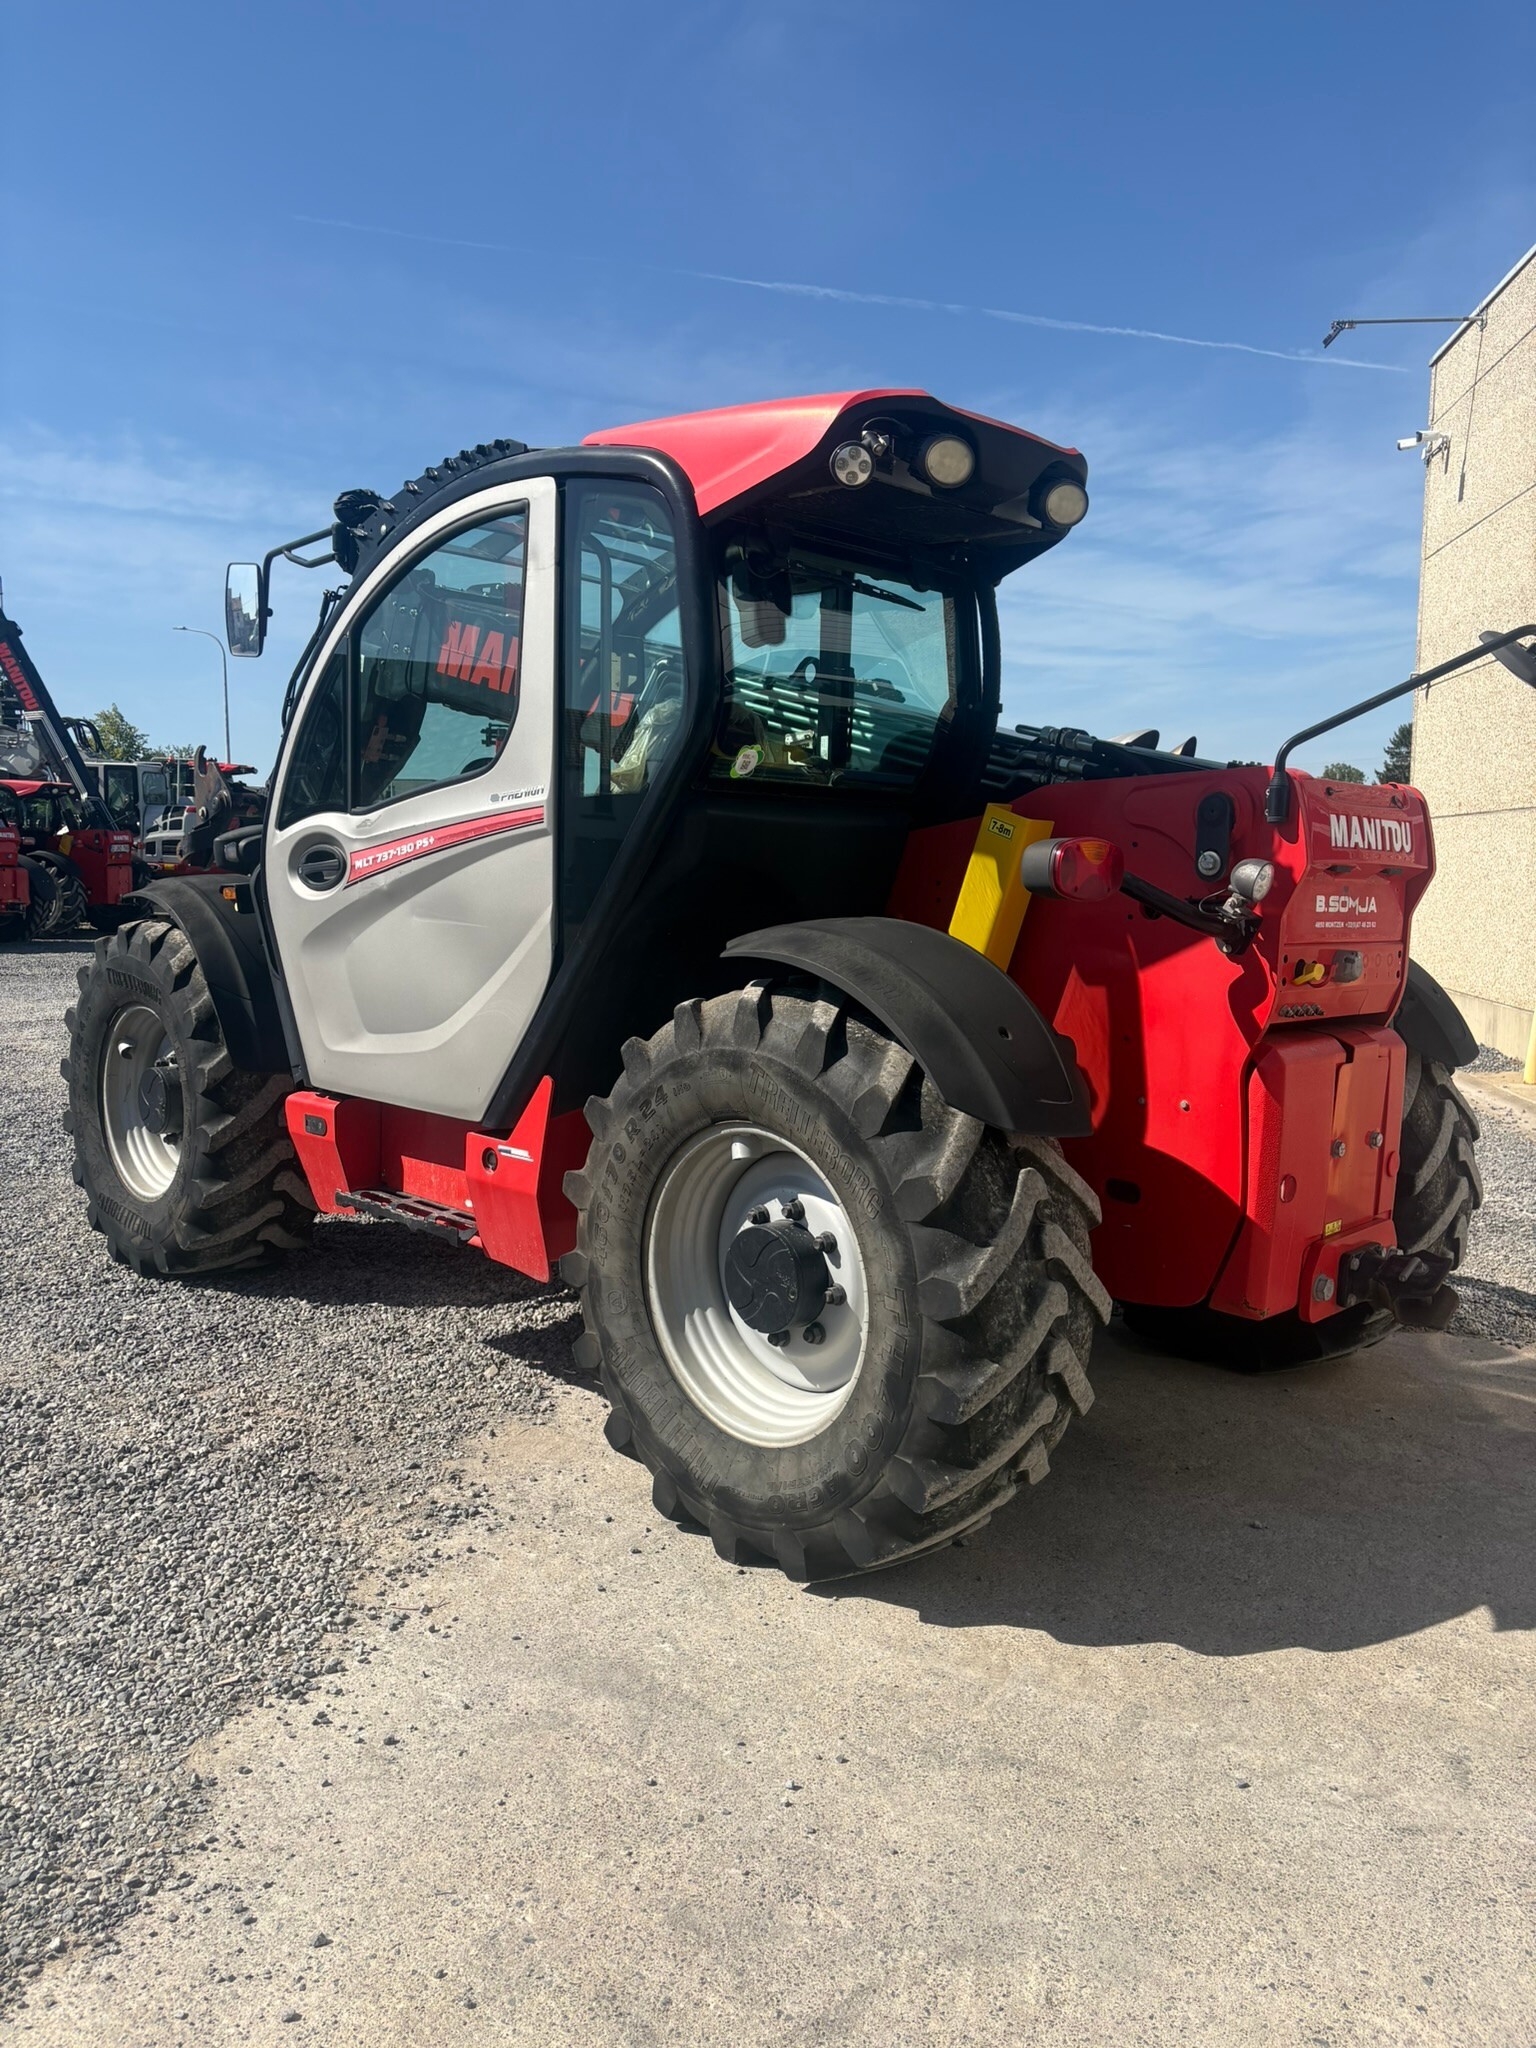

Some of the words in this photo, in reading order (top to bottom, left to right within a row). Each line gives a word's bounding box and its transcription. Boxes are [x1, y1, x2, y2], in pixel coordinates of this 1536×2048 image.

[990, 820, 1012, 837] 7-8m
[1329, 814, 1412, 853] MANITOU
[354, 856, 374, 870] MLT
[415, 835, 435, 850] PS+
[750, 1061, 884, 1219] TRELLEBORG
